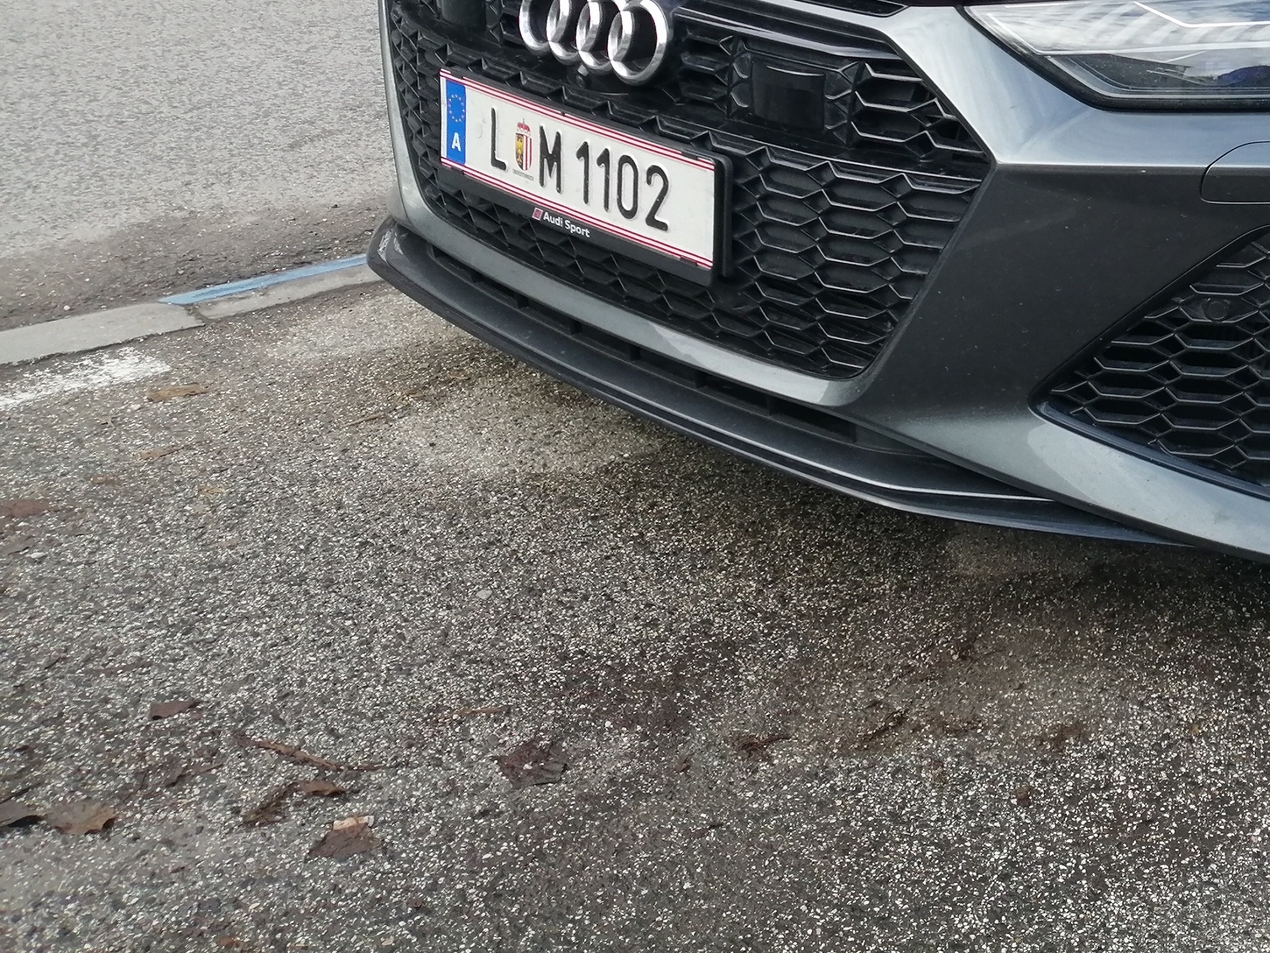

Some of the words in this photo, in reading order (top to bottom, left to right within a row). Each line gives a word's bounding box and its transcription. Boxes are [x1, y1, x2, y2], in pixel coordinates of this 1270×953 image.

[452, 132, 462, 152] A
[543, 211, 563, 227] Audi
[564, 220, 591, 238] Sport
